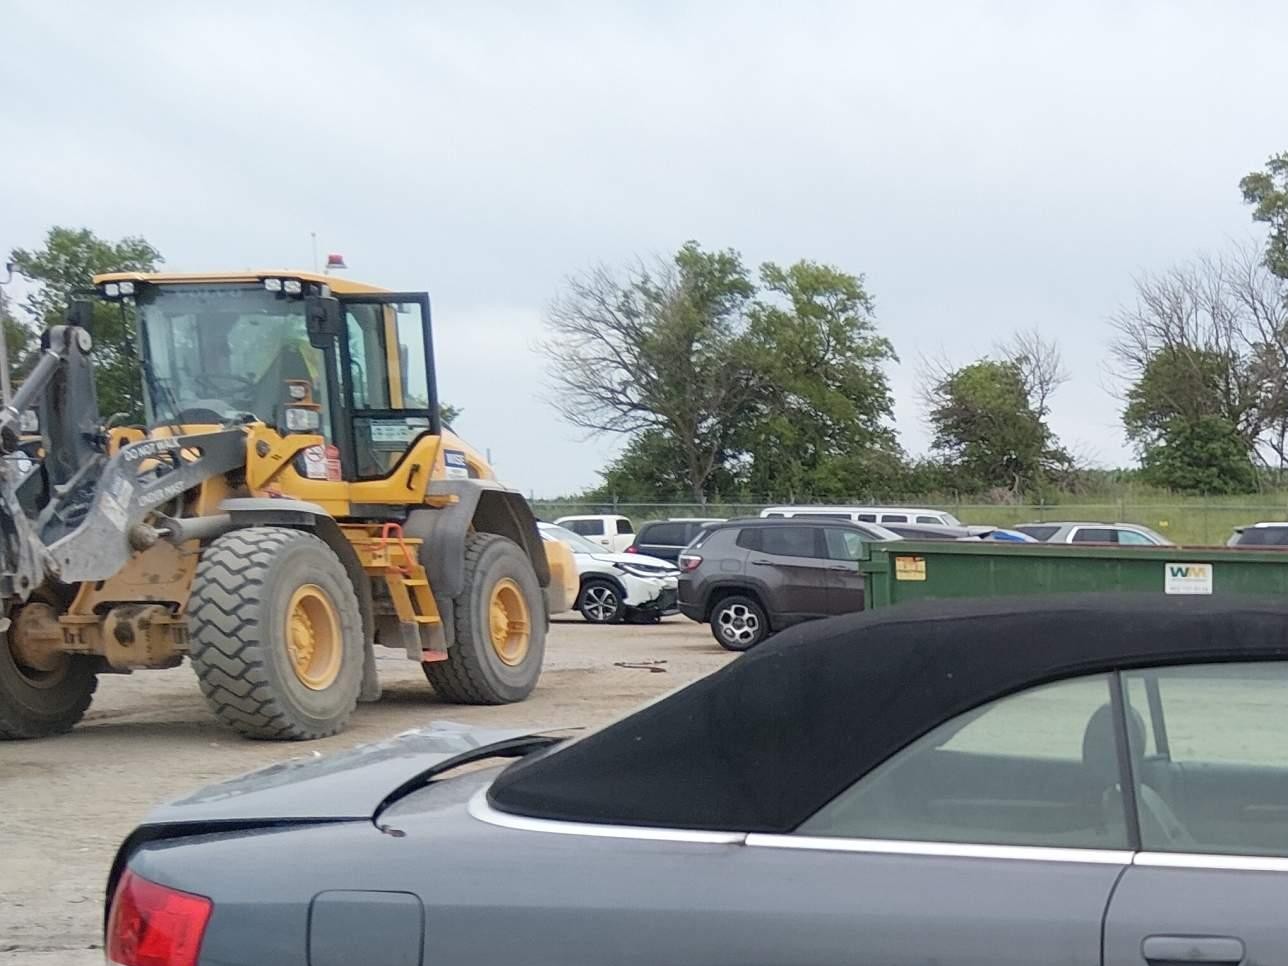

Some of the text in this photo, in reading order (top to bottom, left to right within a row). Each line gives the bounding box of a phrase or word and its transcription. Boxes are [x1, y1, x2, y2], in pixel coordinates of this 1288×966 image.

[124, 447, 139, 462] DO
[138, 442, 157, 457] NOT
[1170, 567, 1206, 578] WM
